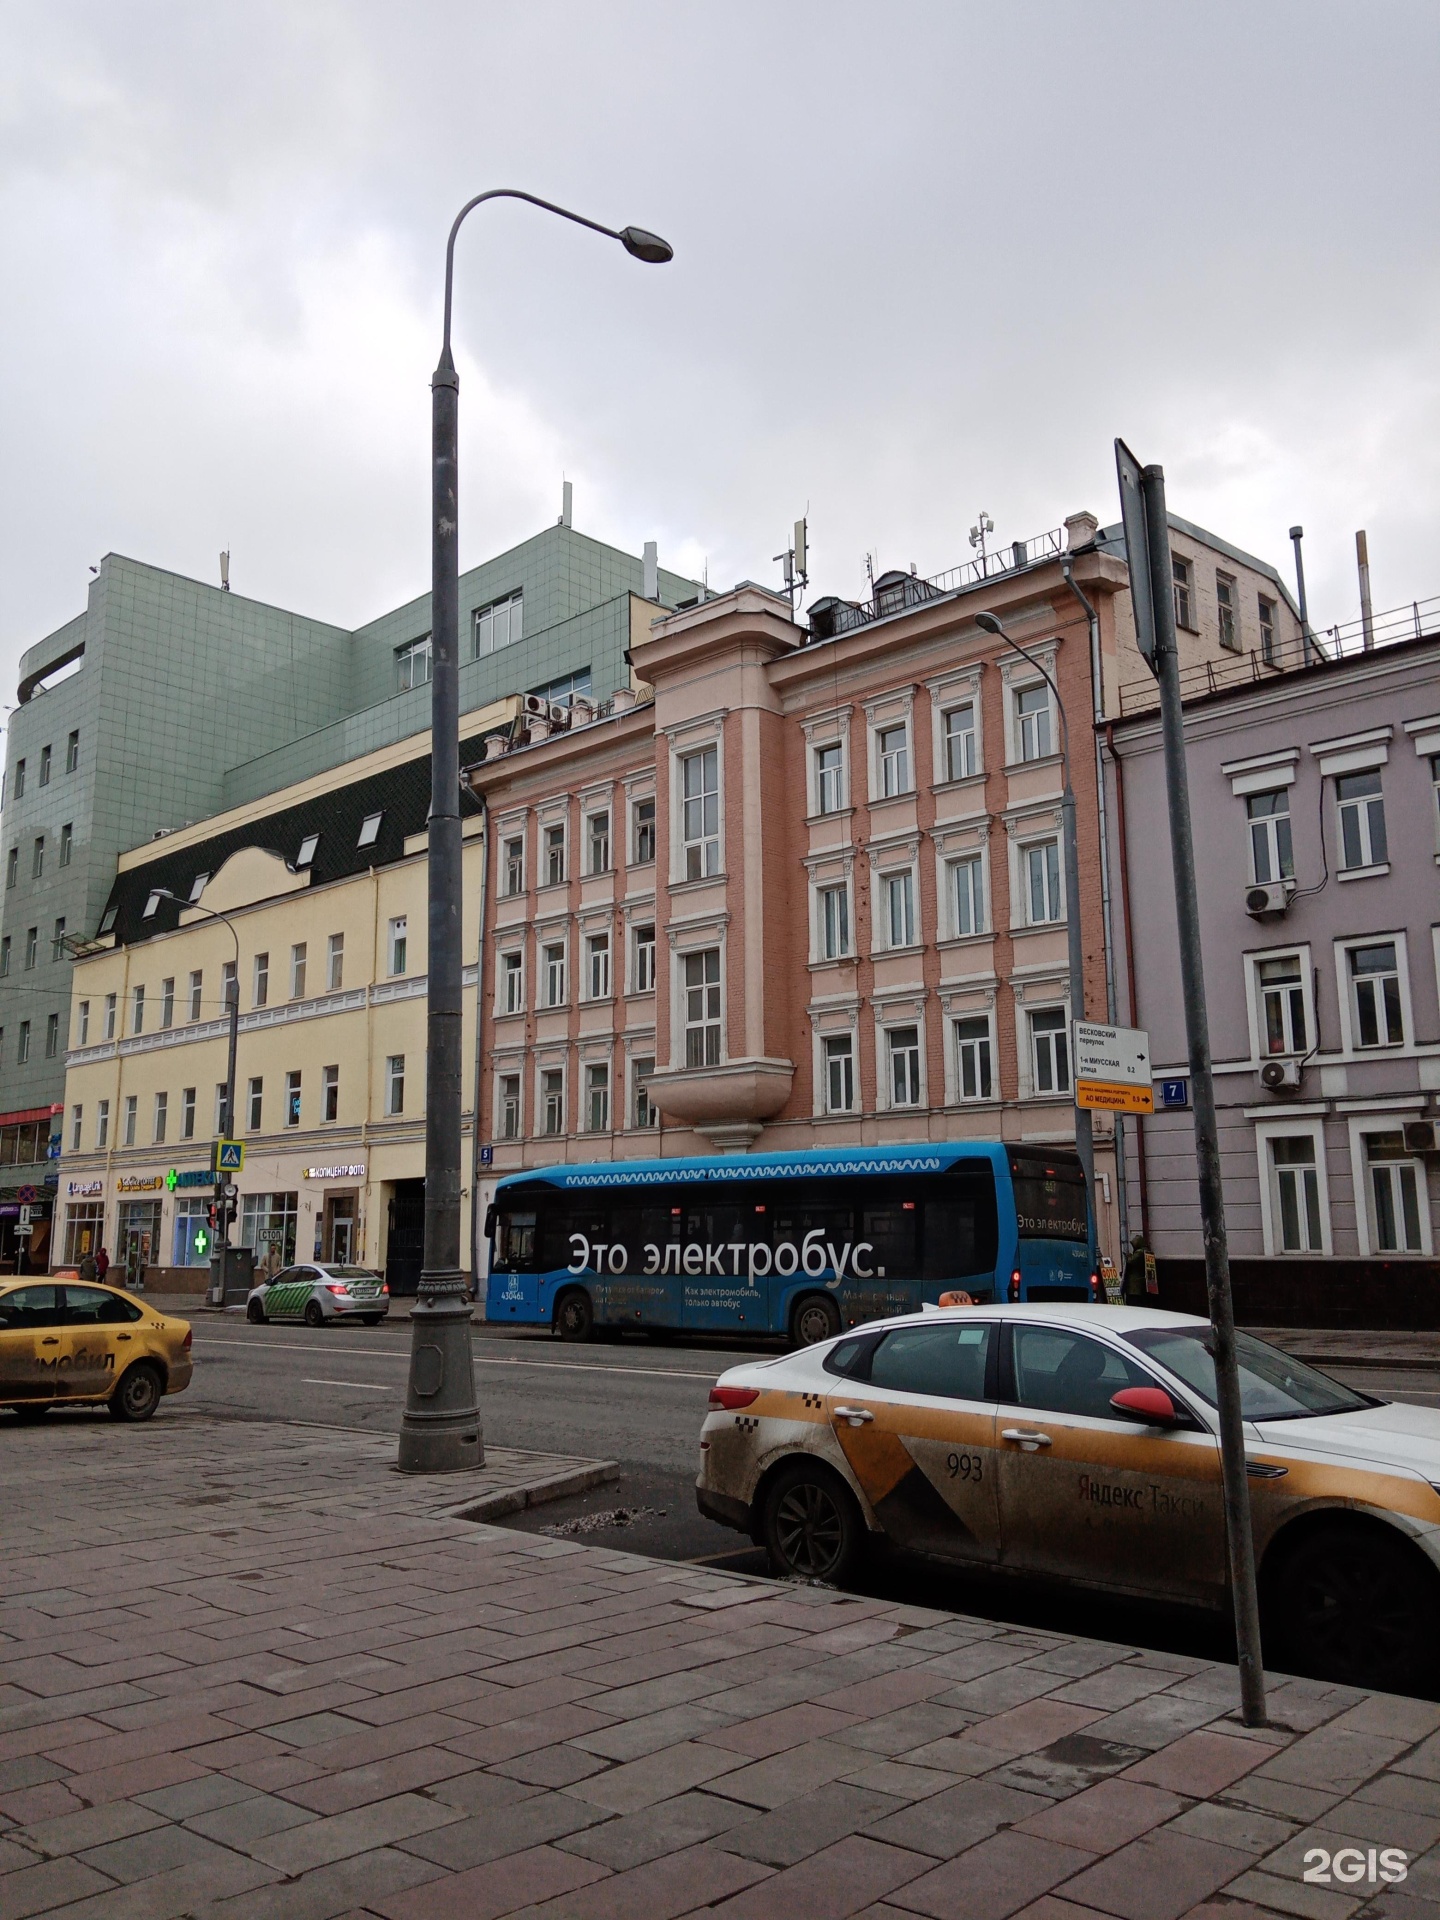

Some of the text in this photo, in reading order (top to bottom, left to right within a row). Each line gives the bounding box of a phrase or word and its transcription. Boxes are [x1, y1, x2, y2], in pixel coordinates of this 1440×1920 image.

[1079, 1027, 1117, 1039] ВЕСКОВСКИЙ
[1079, 1037, 1105, 1046] переулок
[1089, 1057, 1120, 1067] МИУССКАЯ
[1169, 1084, 1177, 1097] 7
[1094, 1095, 1126, 1105] МЕДИЦИНА
[483, 1149, 488, 1159] 5
[314, 1165, 349, 1179] КОПИЦЕНТР
[348, 1164, 366, 1176] ФОТО
[1017, 1214, 1035, 1228] Это
[262, 1230, 282, 1240] СТОП
[567, 1228, 886, 1289] Это электробус.
[500, 1291, 525, 1301] 430461
[684, 1286, 761, 1299] Как электромобиль,
[684, 1298, 741, 1309] только автобус
[947, 1452, 983, 1482] 993
[1078, 1474, 1144, 1510] Яндекс
